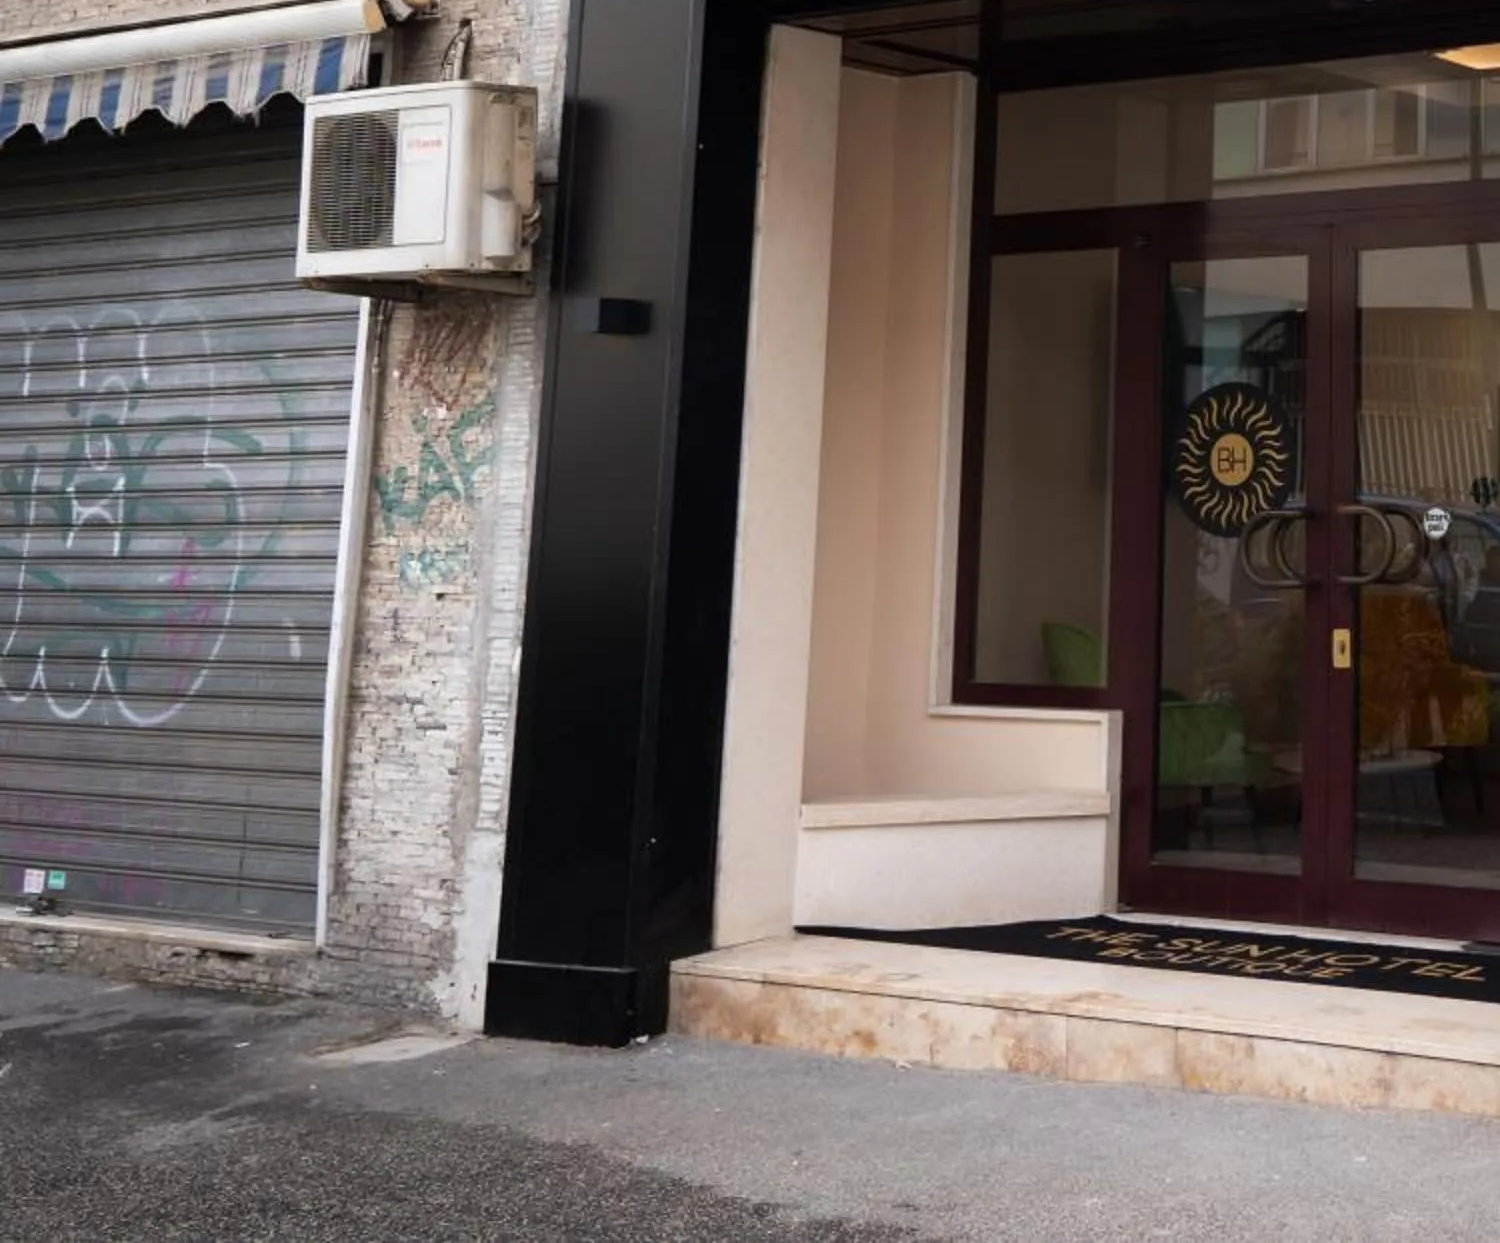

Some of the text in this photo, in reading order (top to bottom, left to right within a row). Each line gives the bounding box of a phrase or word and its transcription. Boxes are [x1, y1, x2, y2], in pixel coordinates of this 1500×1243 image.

[1217, 447, 1248, 473] BH
[1045, 926, 1487, 982] THE SUN HOTEL
[1096, 946, 1354, 979] BOUTIQUE
